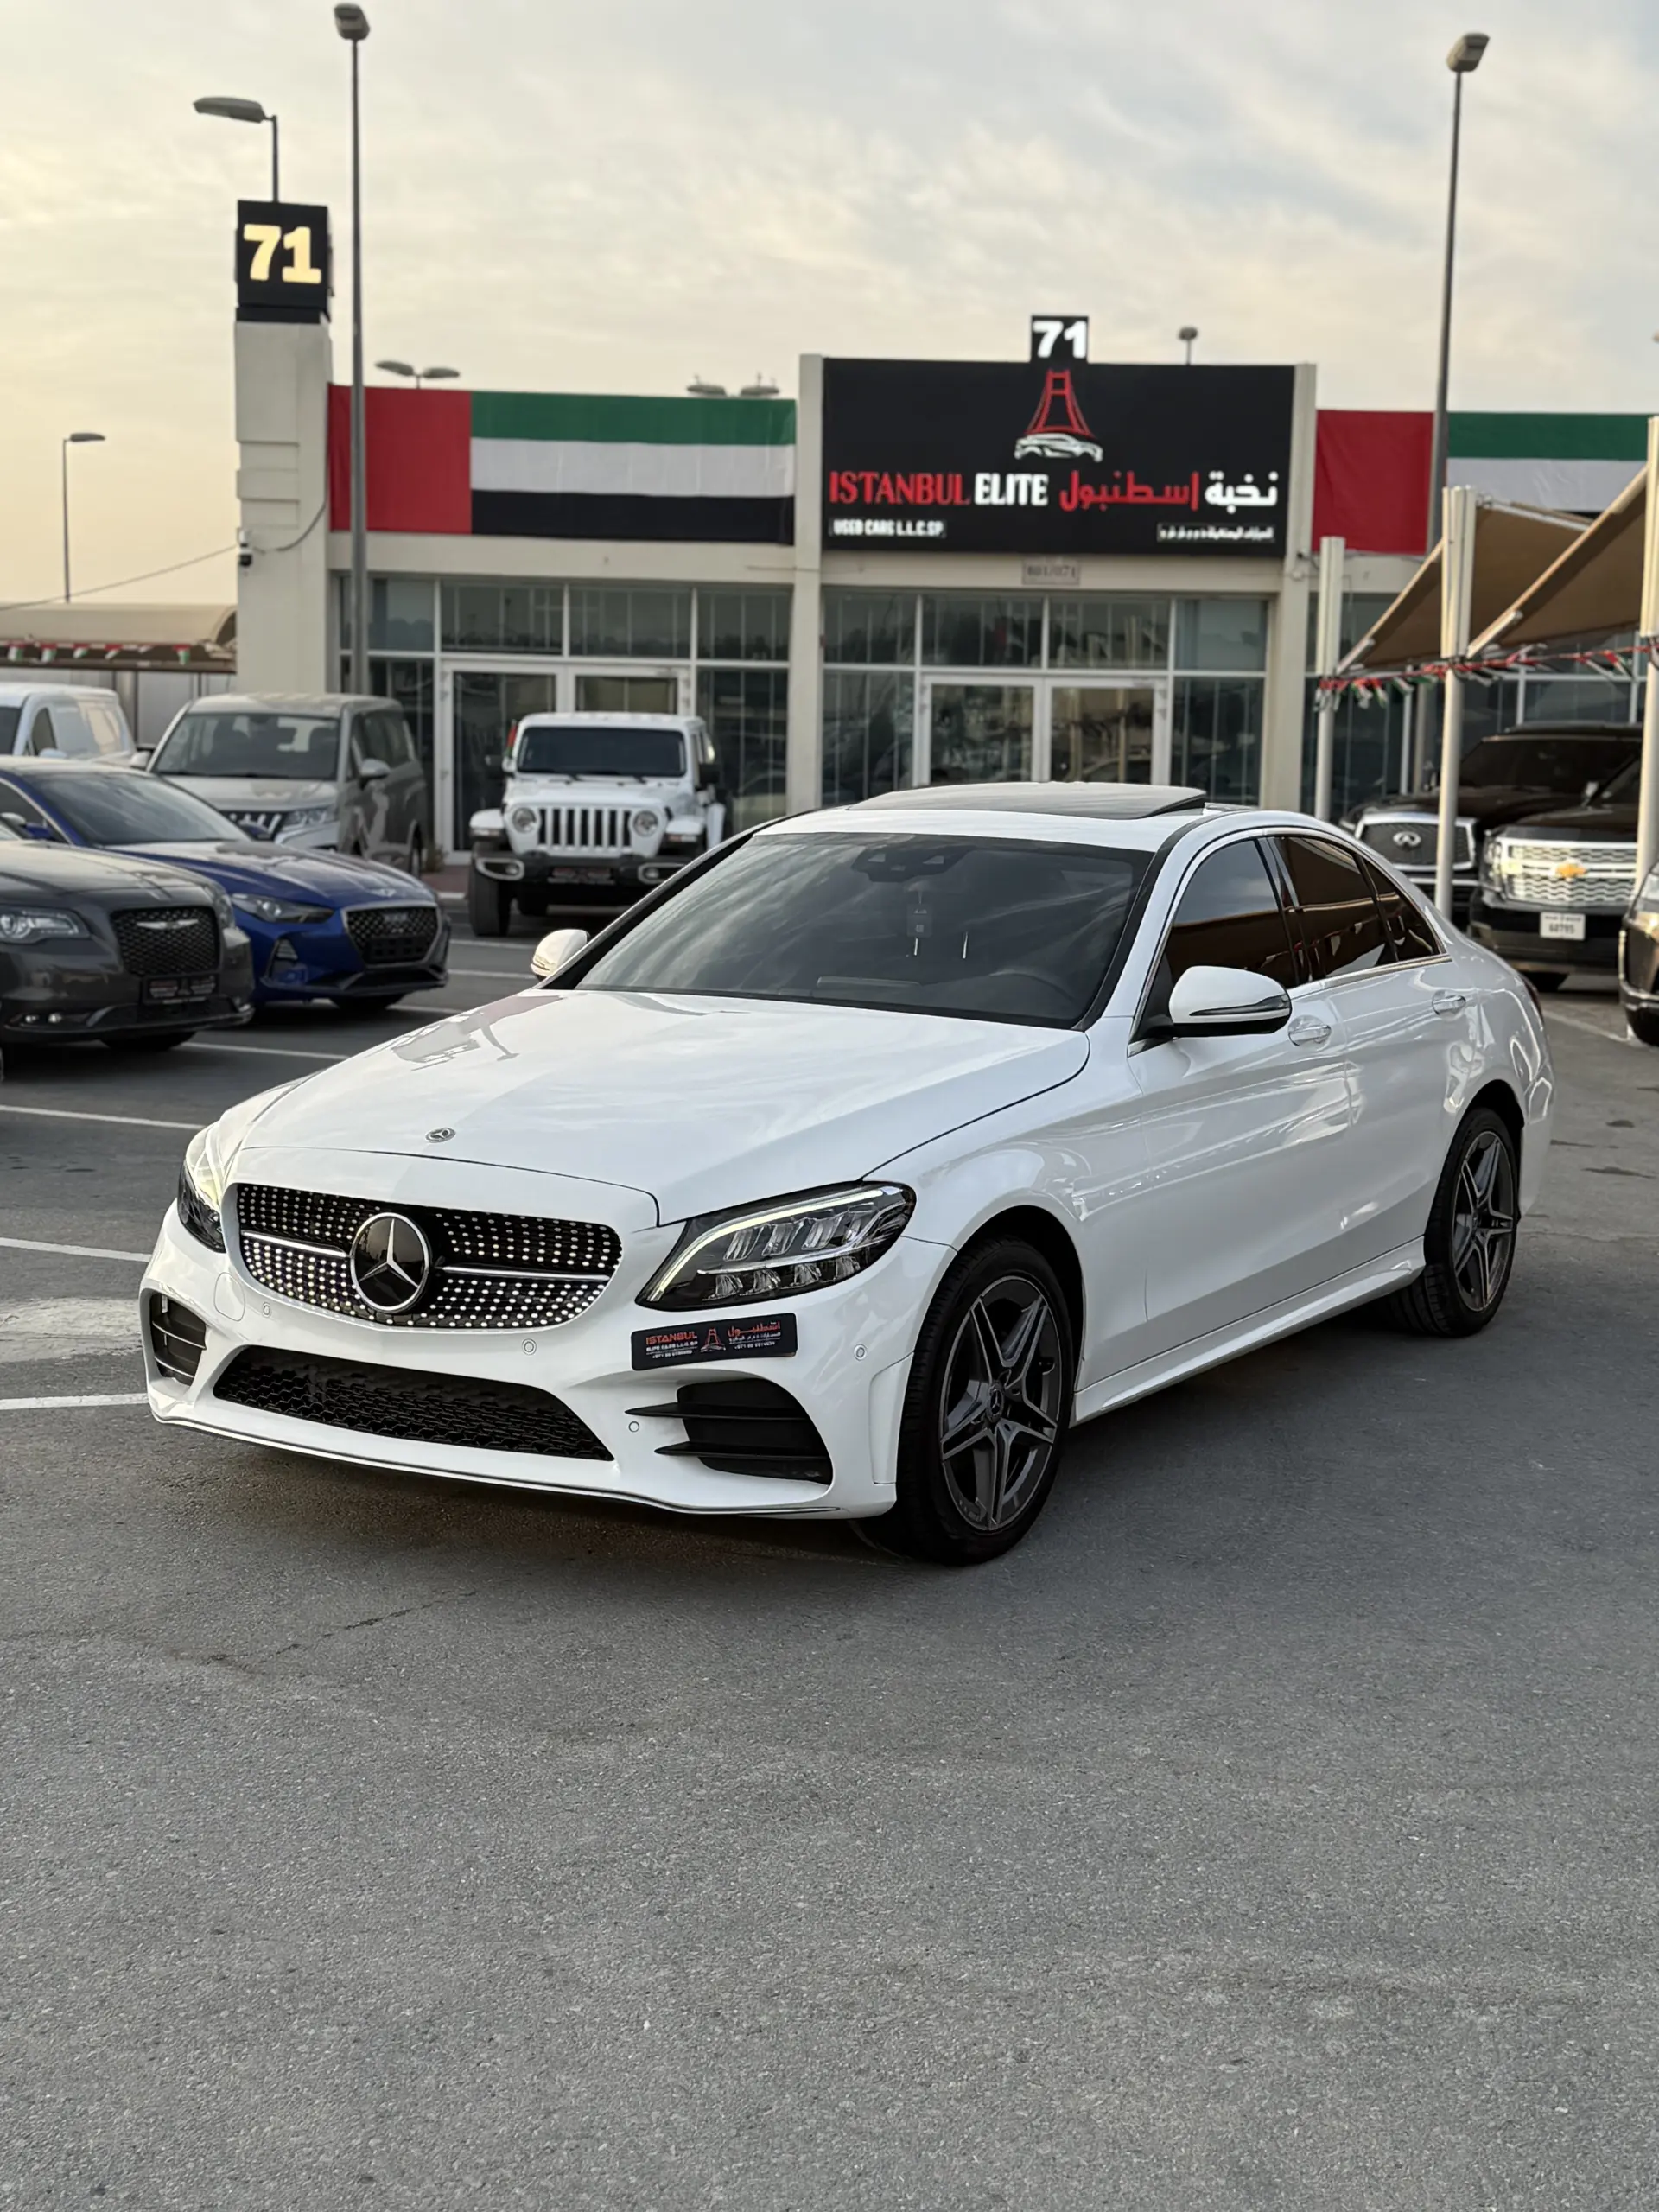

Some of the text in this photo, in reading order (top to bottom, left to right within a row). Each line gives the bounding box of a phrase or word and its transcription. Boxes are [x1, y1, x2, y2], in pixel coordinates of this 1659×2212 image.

[243, 223, 322, 284] 71
[1033, 320, 1088, 359] 71
[830, 471, 1049, 506] ISTANBUL ELITE
[1205, 471, 1279, 514] نخبة
[645, 1331, 697, 1345] ISTANBUL
